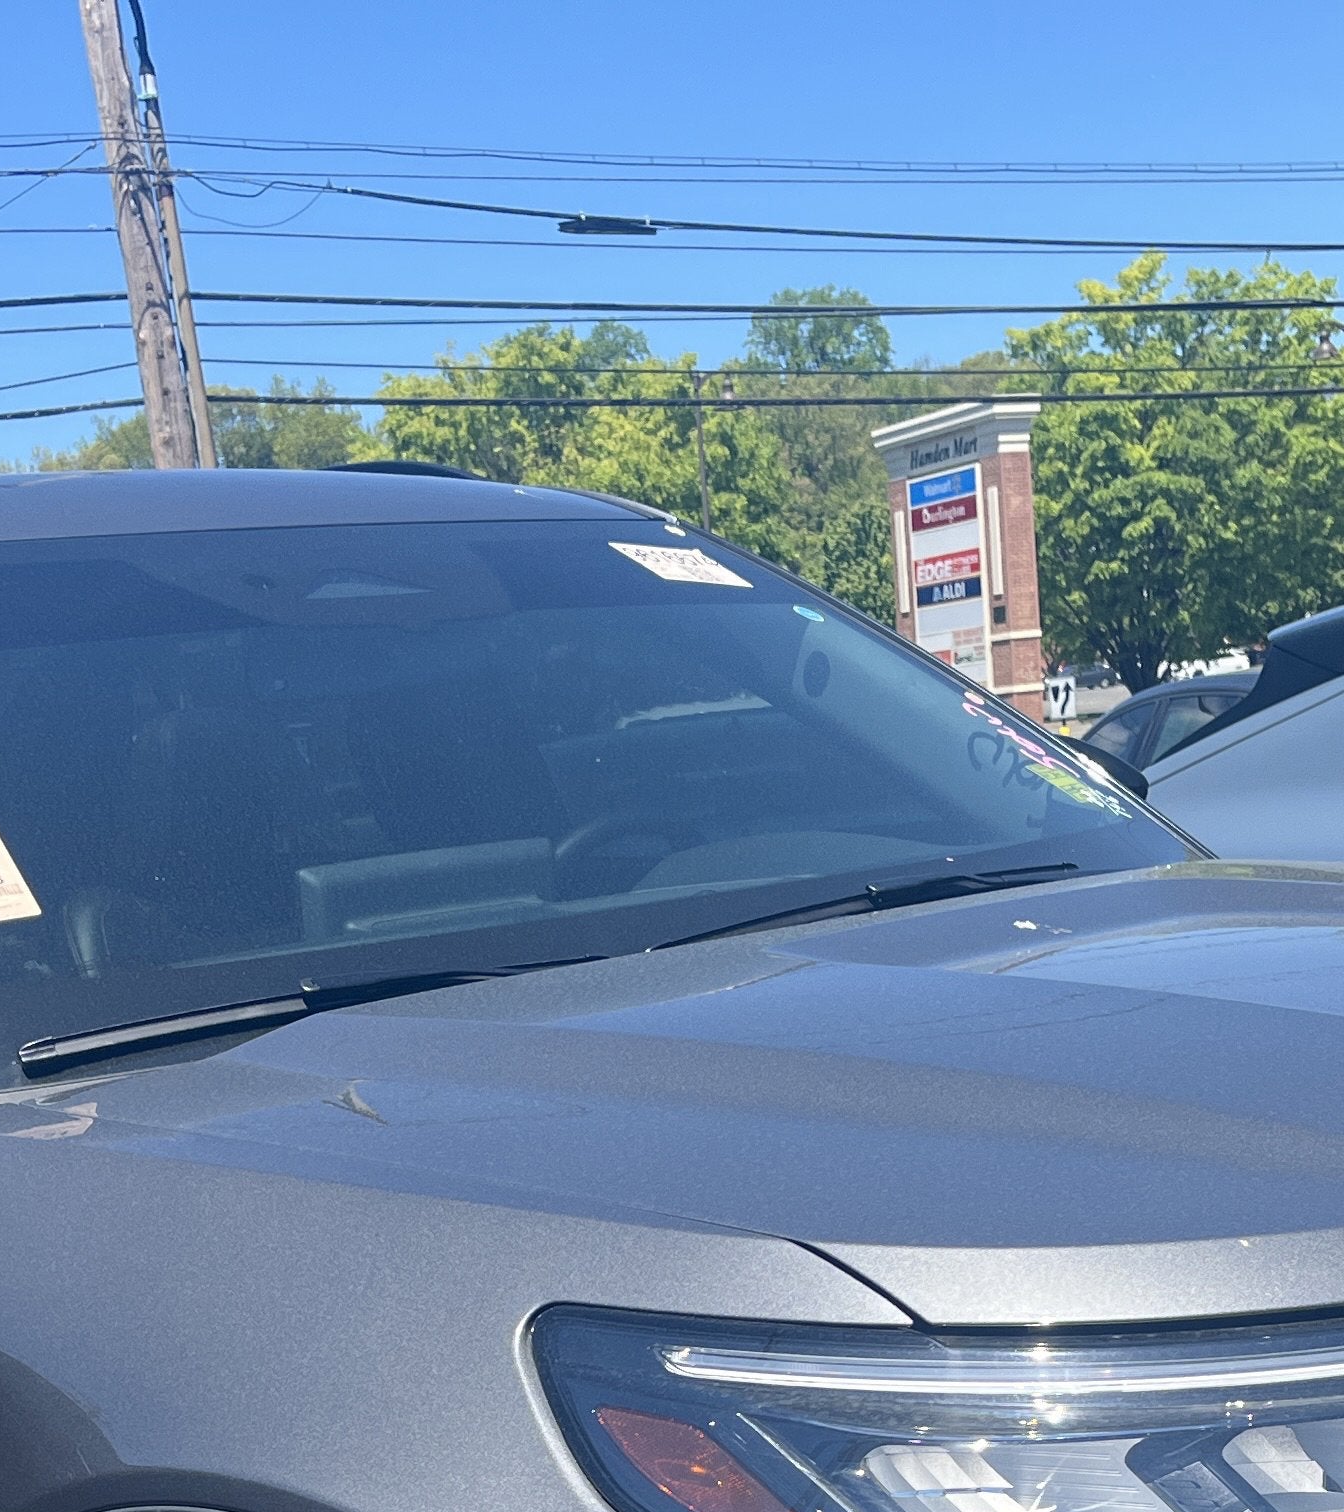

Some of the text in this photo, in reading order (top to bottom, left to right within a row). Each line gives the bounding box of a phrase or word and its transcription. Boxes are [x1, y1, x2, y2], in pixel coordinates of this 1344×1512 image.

[910, 436, 978, 470] Hamden Mart
[917, 559, 953, 583] EDGE
[942, 581, 966, 600] ALDI
